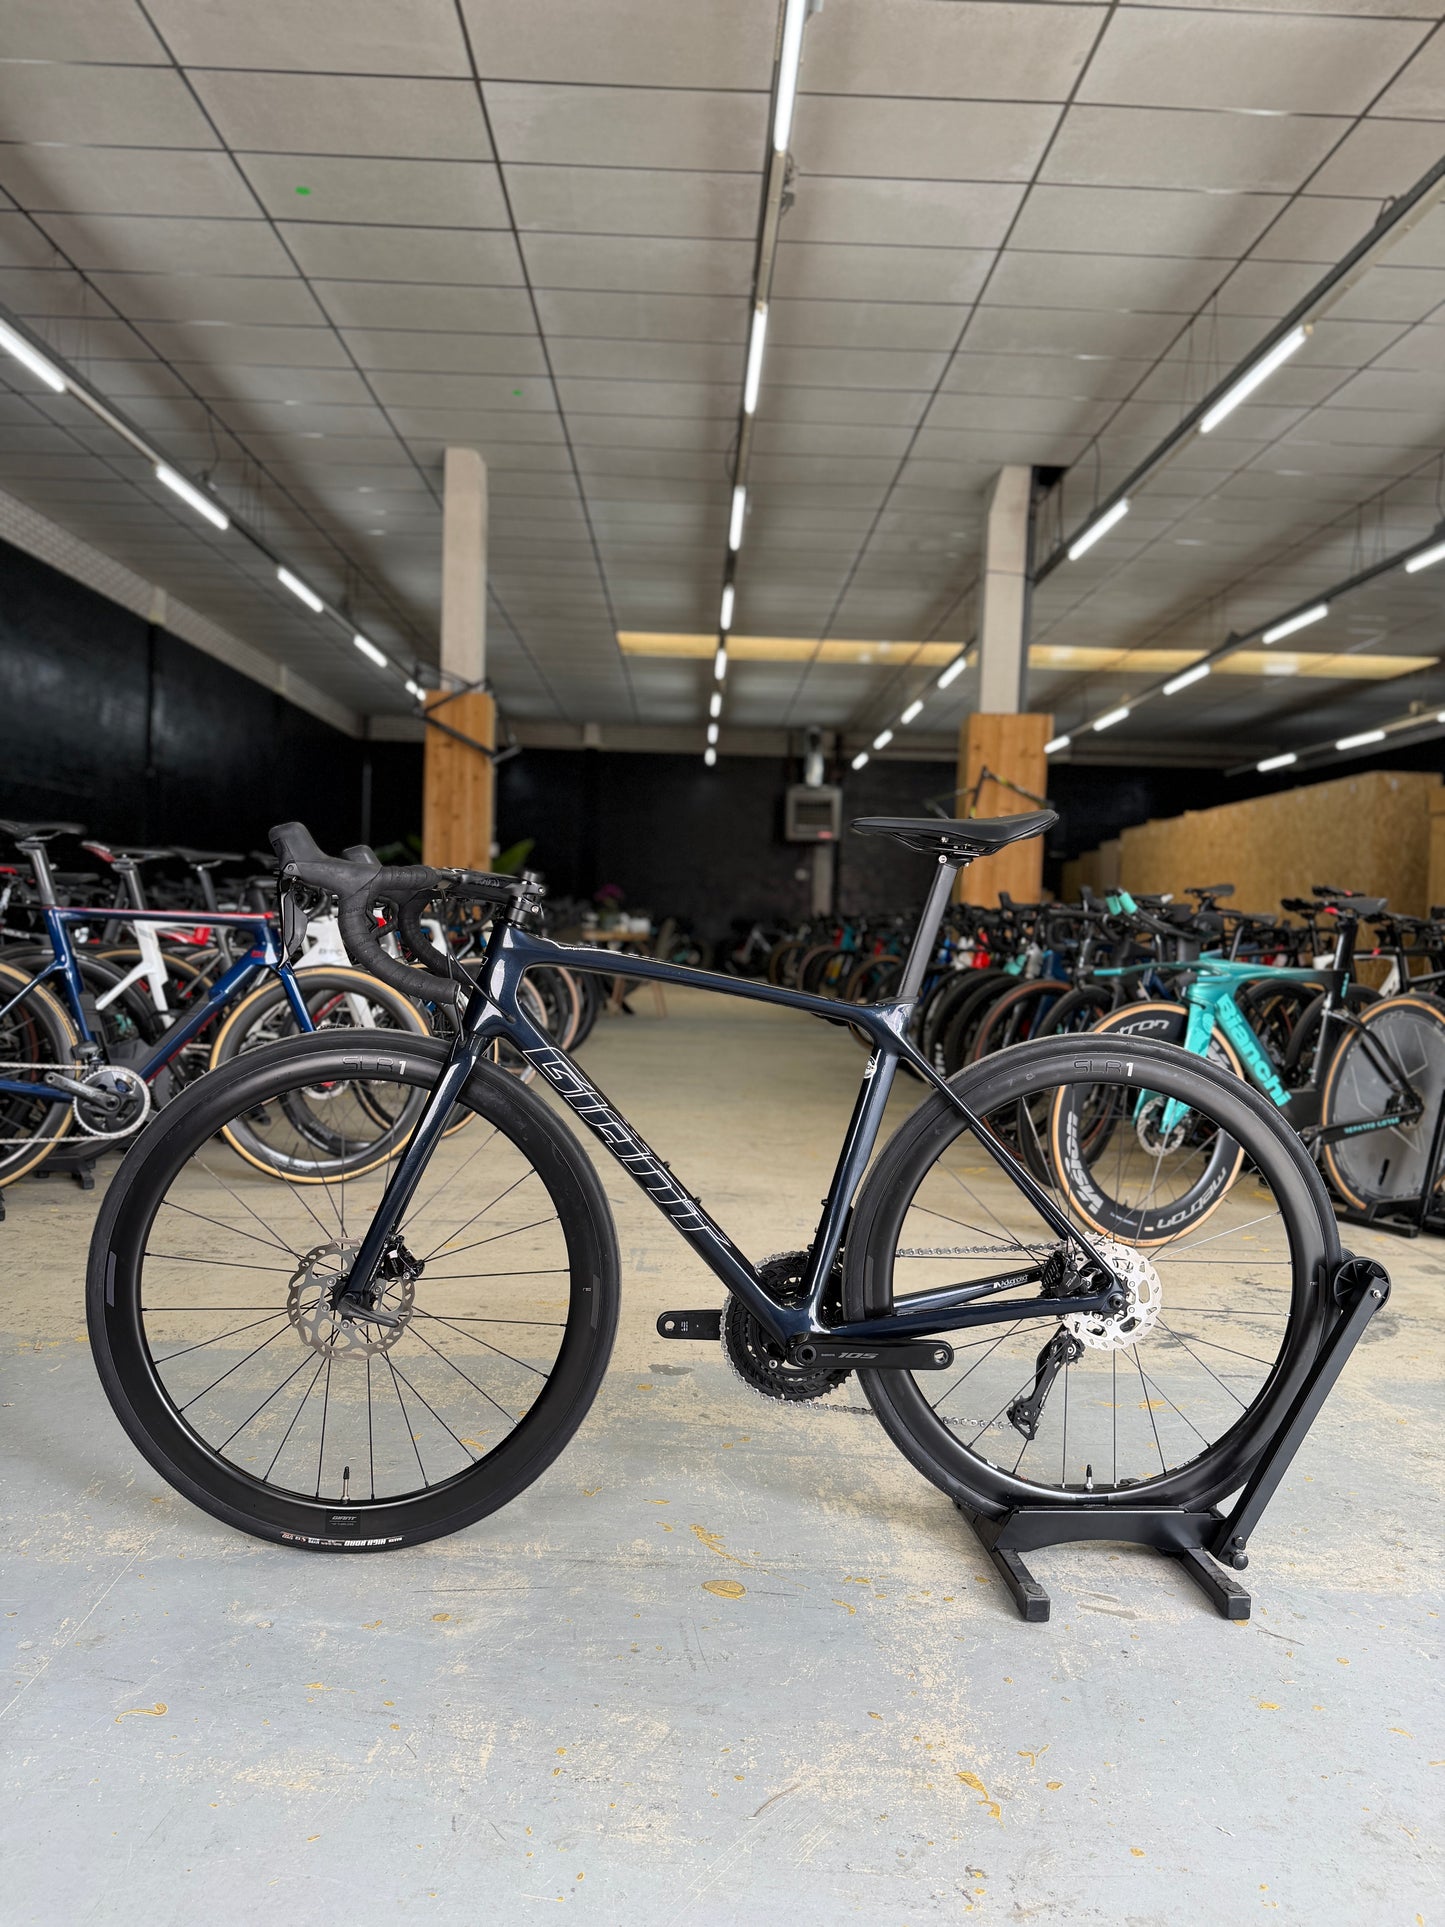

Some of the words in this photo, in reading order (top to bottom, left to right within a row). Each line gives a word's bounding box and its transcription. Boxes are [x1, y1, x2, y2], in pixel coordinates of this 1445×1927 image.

[1116, 1019, 1171, 1035] tron
[1214, 993, 1292, 1108] Bianchi
[1156, 1166, 1227, 1229] metron
[838, 1352, 879, 1360] 105
[367, 1538, 386, 1546] HIGH
